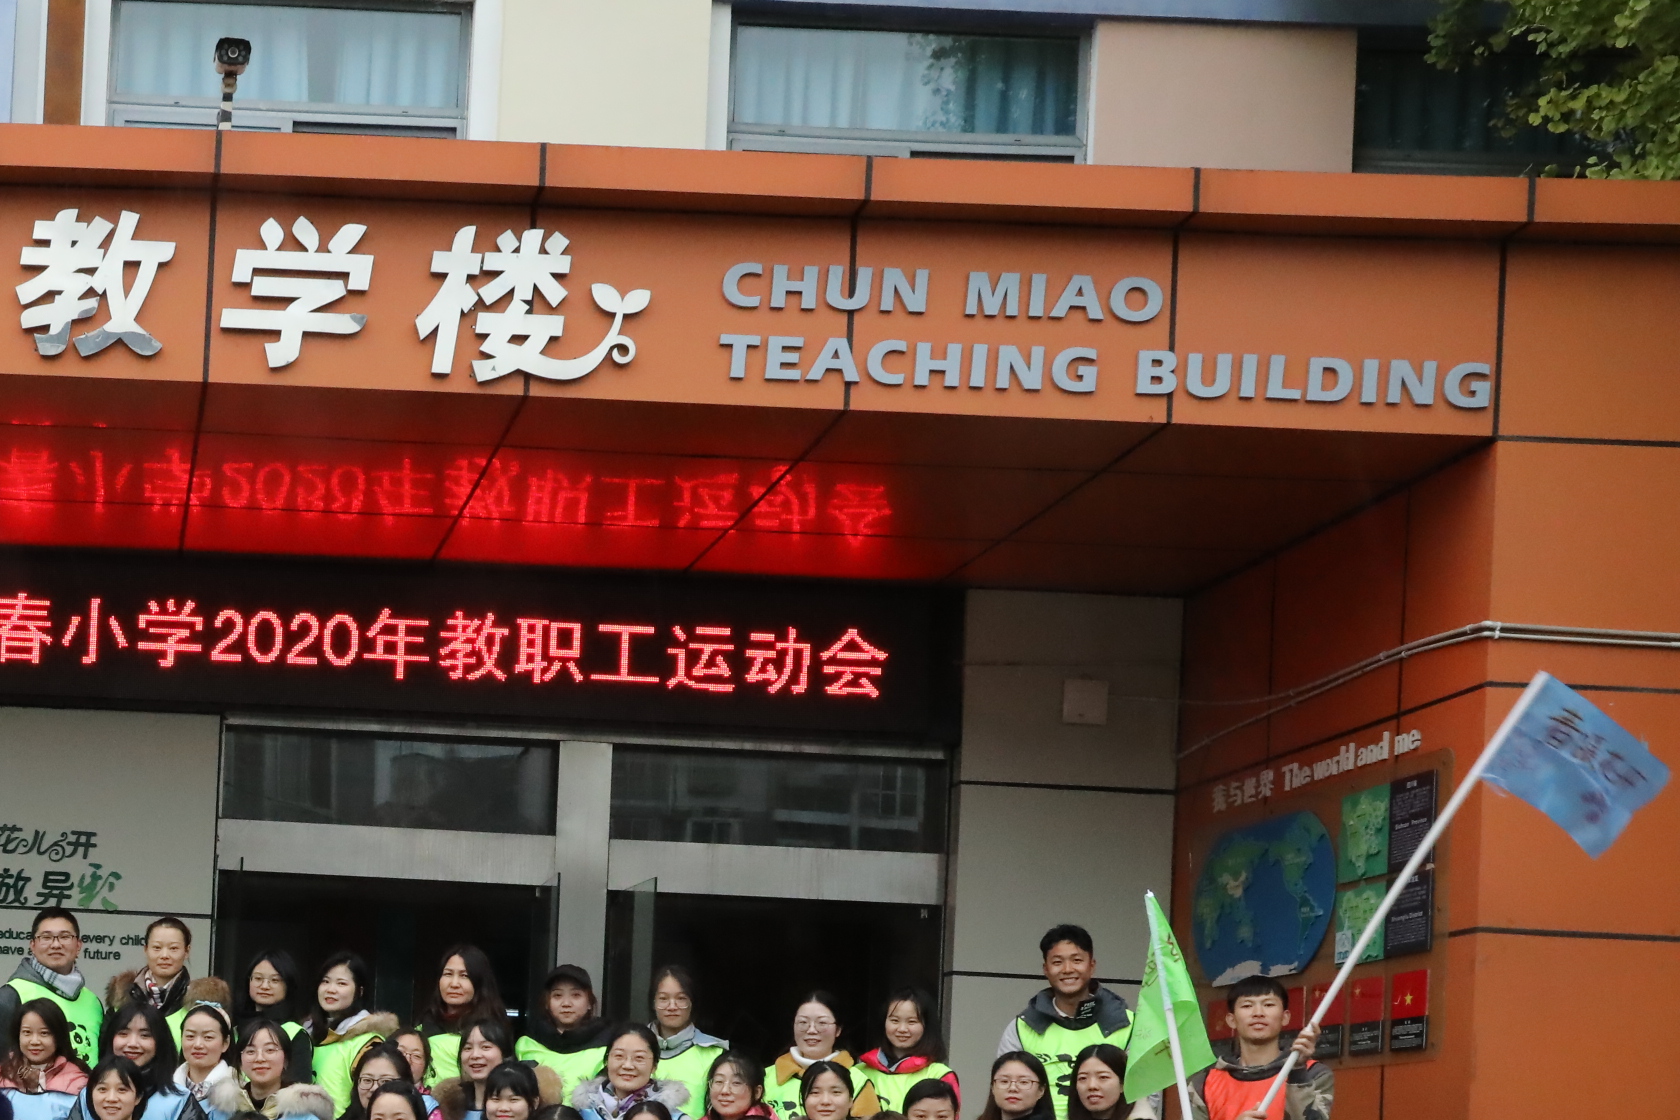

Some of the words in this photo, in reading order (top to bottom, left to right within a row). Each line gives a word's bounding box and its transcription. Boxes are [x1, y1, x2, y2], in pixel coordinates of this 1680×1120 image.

[721, 261, 931, 313] CHUN
[964, 270, 1165, 322] MIAO
[719, 333, 1099, 394] TEACHING
[1134, 349, 1492, 409] BUILDING
[1282, 762, 1312, 791] The
[1312, 743, 1356, 780] world
[1357, 731, 1390, 767] and
[1394, 729, 1423, 755] me
[81, 933, 116, 946] every
[83, 948, 121, 960] future
